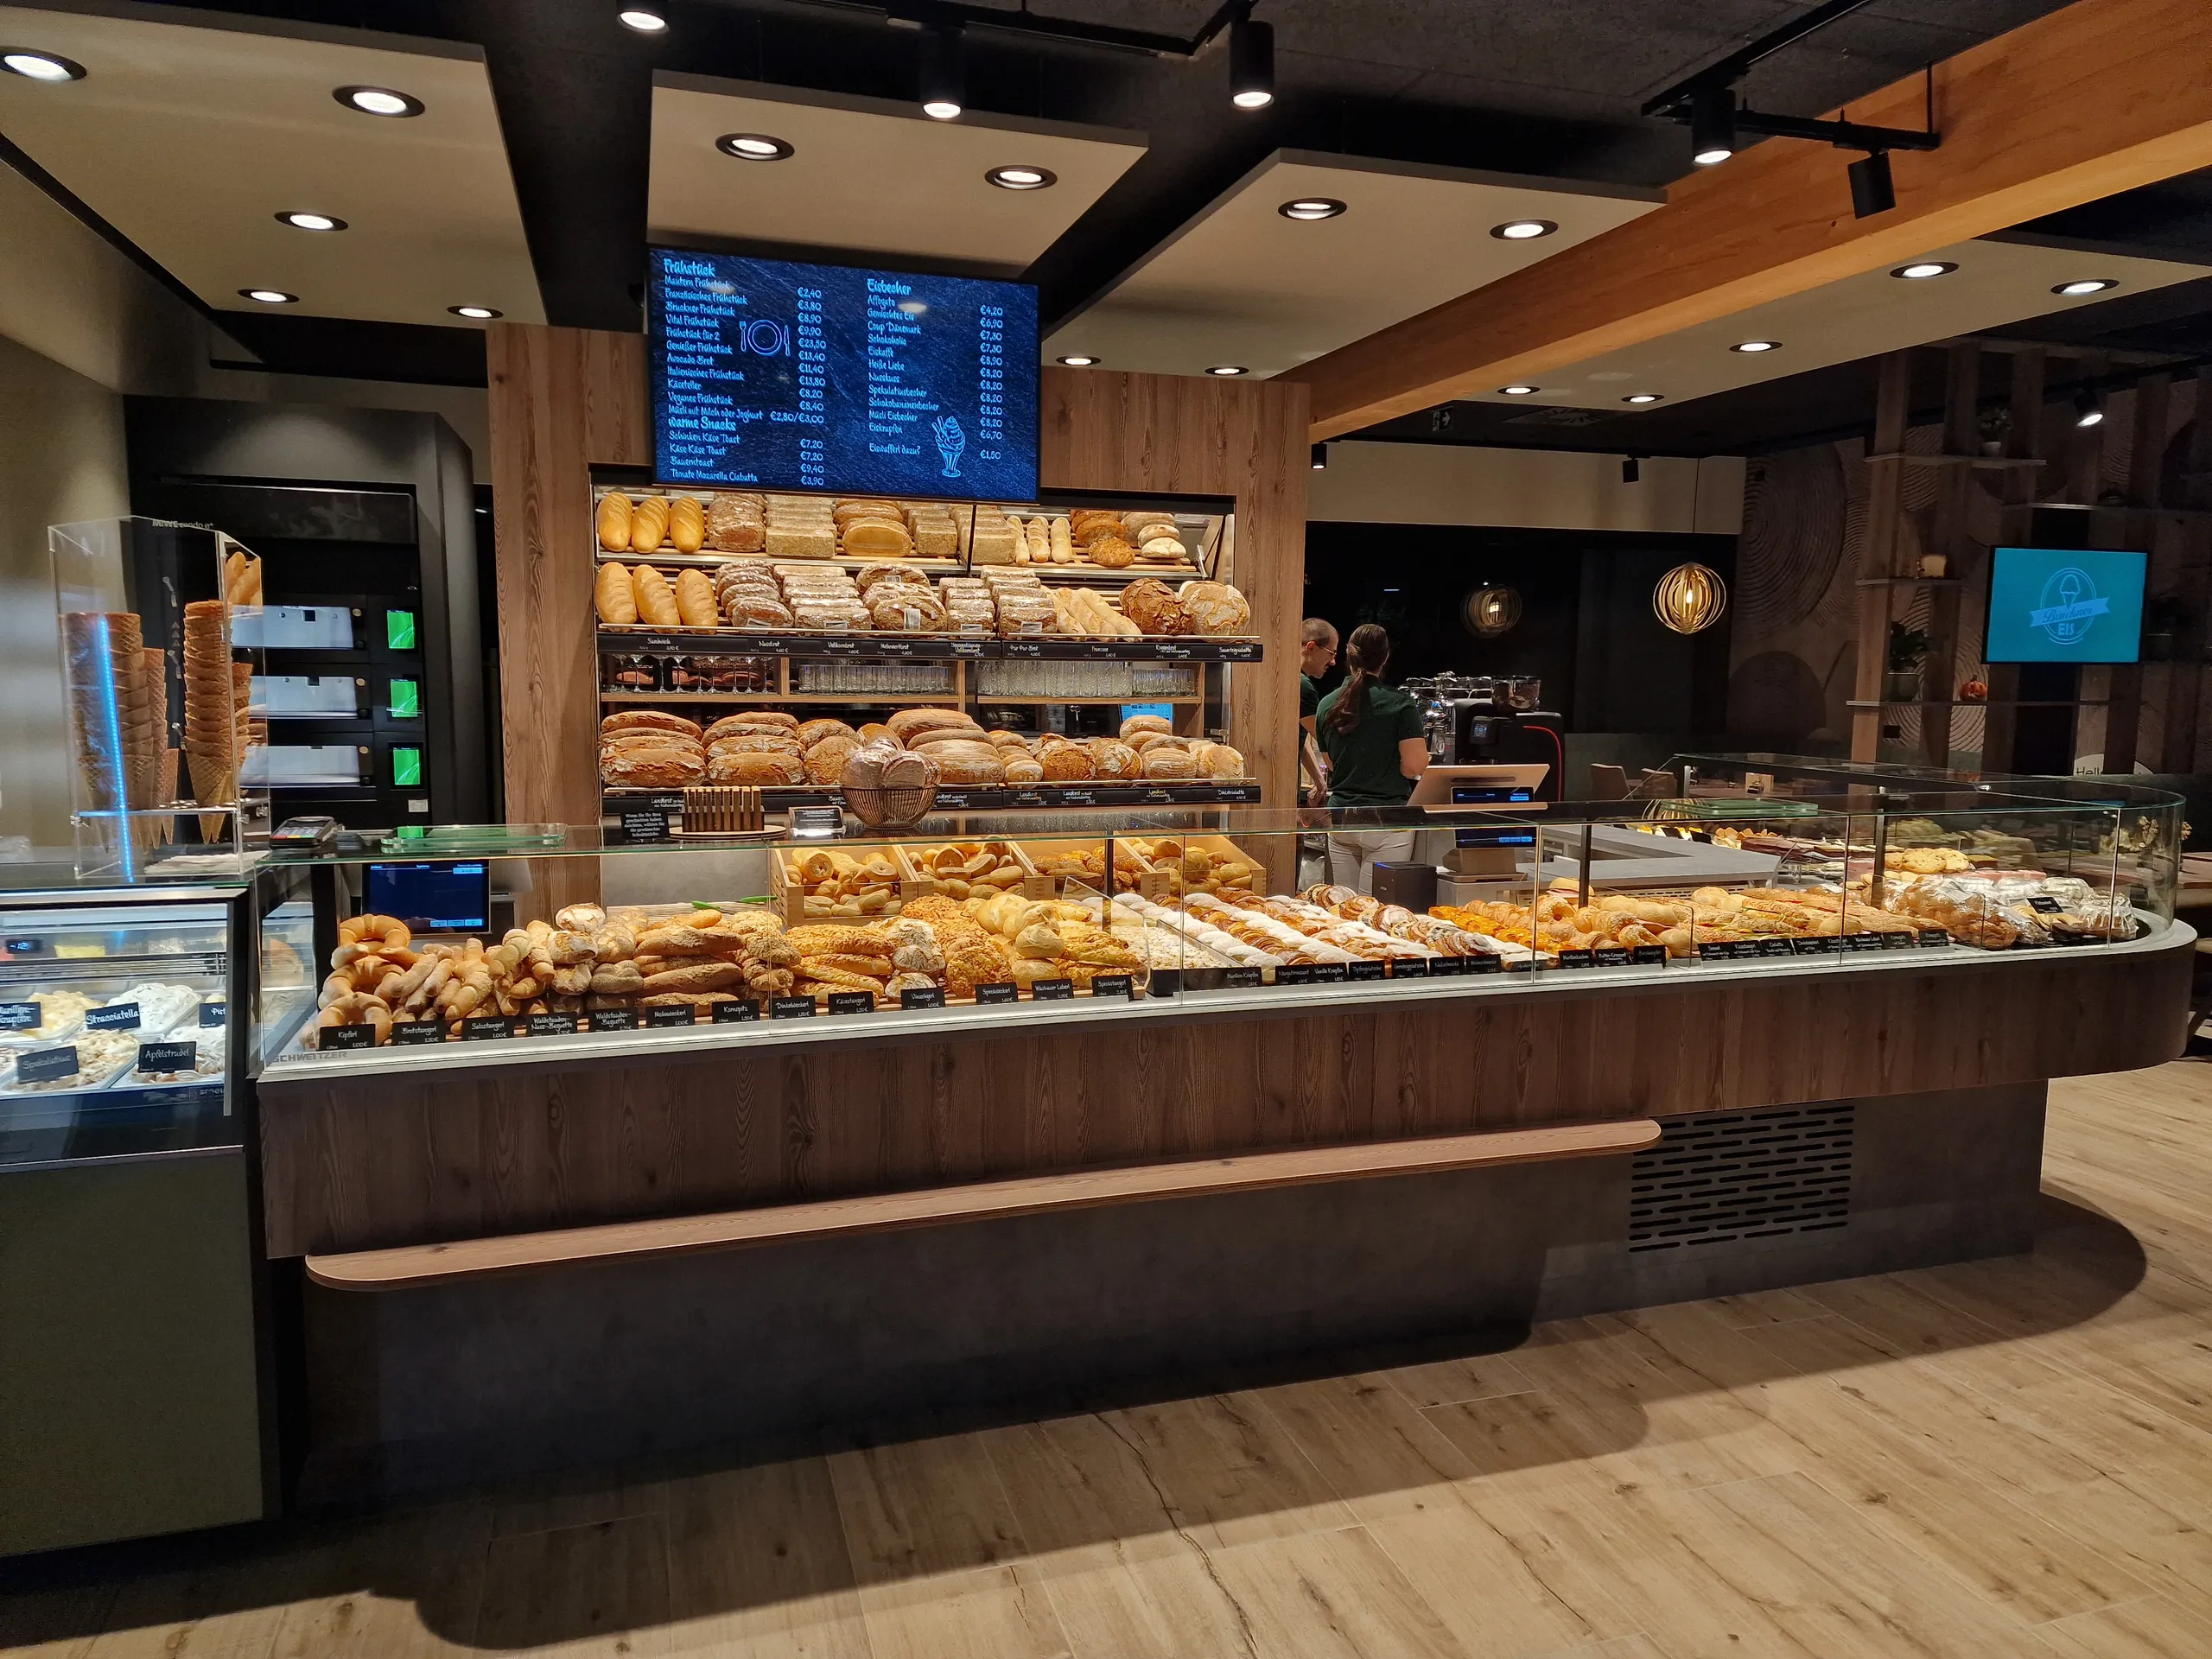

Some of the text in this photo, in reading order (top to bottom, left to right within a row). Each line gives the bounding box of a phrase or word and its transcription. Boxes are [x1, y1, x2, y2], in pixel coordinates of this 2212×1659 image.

[664, 258, 715, 277] Frühstück
[665, 275, 730, 290] Mautern Frühstück
[867, 278, 912, 296] Eisbecher
[665, 288, 748, 306] Französisches Frühstück
[798, 287, 822, 299] €2,40
[797, 299, 822, 311] €3,80
[868, 295, 895, 309] Affogato
[665, 301, 735, 317] Bruckner Frühstück
[868, 308, 915, 321] Gemischtes Eis
[980, 304, 1003, 317] €4,20
[665, 315, 720, 328] Vital Frühstück
[798, 312, 822, 325] €8,90
[980, 317, 1003, 329] €6,90
[666, 327, 721, 340] Frühstück für 2
[798, 325, 822, 337] €9,90
[868, 320, 922, 335] Coup Dänemark
[980, 330, 1002, 342] €7,30
[666, 340, 733, 355] Genießer Frühstück
[798, 337, 827, 350] €23,50
[980, 342, 1002, 354] €7,30
[667, 353, 715, 366] Avocado Brot
[798, 351, 826, 362] €13,40
[980, 354, 1003, 366] €8,90
[798, 363, 824, 375] €11,40
[868, 358, 906, 372] Heiße Liebe
[667, 365, 745, 381] Italienisches Frühstück
[868, 372, 900, 384] Nusskuss
[980, 367, 1003, 379] €8,20
[668, 378, 702, 391] Käseteller
[798, 375, 826, 387] €13,80
[980, 380, 1003, 391] €8,20
[798, 388, 823, 399] €8,20
[868, 384, 928, 397] Spekulatiusbecher
[668, 391, 733, 406] Veganes Frühstück
[868, 397, 940, 412] Schokobananenbecher
[980, 392, 1003, 404] €8,20
[799, 400, 824, 411] €8,40
[980, 404, 1003, 416] €8,20
[669, 404, 764, 423] Müsli mit Milch oder Joghurt
[868, 410, 919, 422] Müsli Eisbecher
[701, 416, 737, 432] Snacks
[980, 416, 1003, 429] €8,20
[868, 423, 904, 437] Eiskrapfen
[980, 429, 1003, 441] €6,70
[669, 430, 741, 444] Schinken Käse Toast
[800, 438, 823, 449] €7,20
[670, 442, 727, 456] Käse Käse Toast
[869, 442, 921, 455] Eiswafferl dazu?
[980, 449, 1002, 460] €1,50
[670, 456, 715, 467] Bauerntoast
[800, 451, 823, 461] €7,20
[671, 468, 759, 482] Tomate Mozarella Ciabatta
[800, 463, 824, 474] €9,40
[800, 475, 824, 486] €3,90
[2042, 606, 2094, 623] Bruckner
[2058, 622, 2075, 636] EIS
[2075, 766, 2103, 776] Hell
[86, 1009, 140, 1025] Stracciatella
[601, 1018, 626, 1027] Baguette
[401, 1027, 437, 1036] Brotstangerl
[472, 1021, 505, 1032] Salzstangerl
[338, 1030, 358, 1042] Kipferl
[145, 1047, 190, 1063] Apfelstrudel
[273, 1052, 347, 1063] SCHWEITZER
